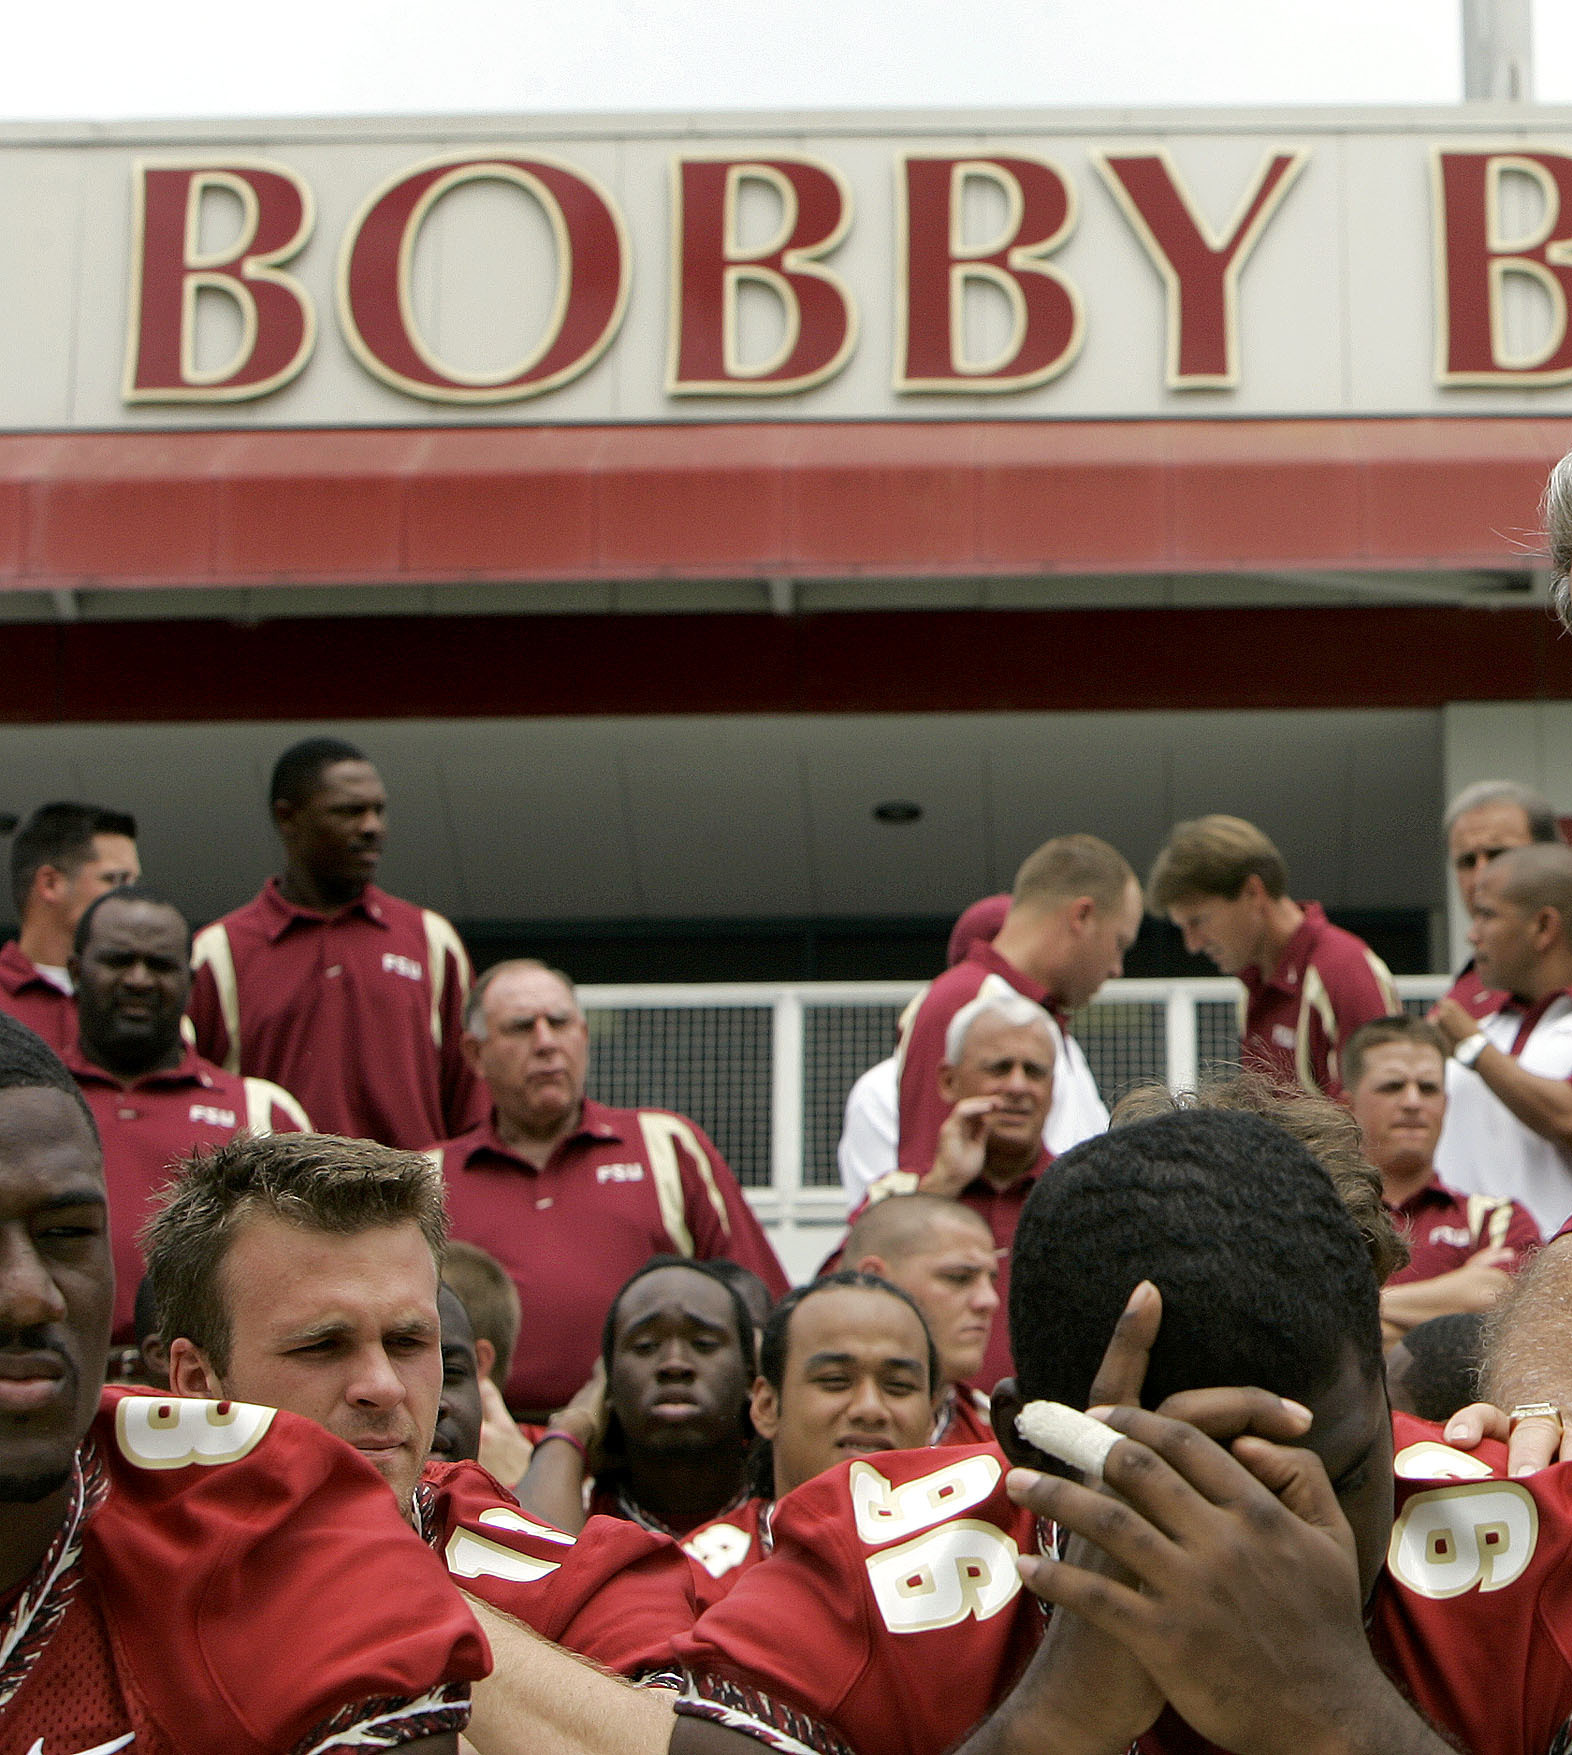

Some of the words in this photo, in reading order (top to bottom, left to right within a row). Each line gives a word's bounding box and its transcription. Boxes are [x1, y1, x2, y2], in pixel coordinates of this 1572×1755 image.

[123, 147, 1310, 402] BOBBY
[189, 1104, 236, 1128] FSU
[596, 1162, 643, 1184] FSU
